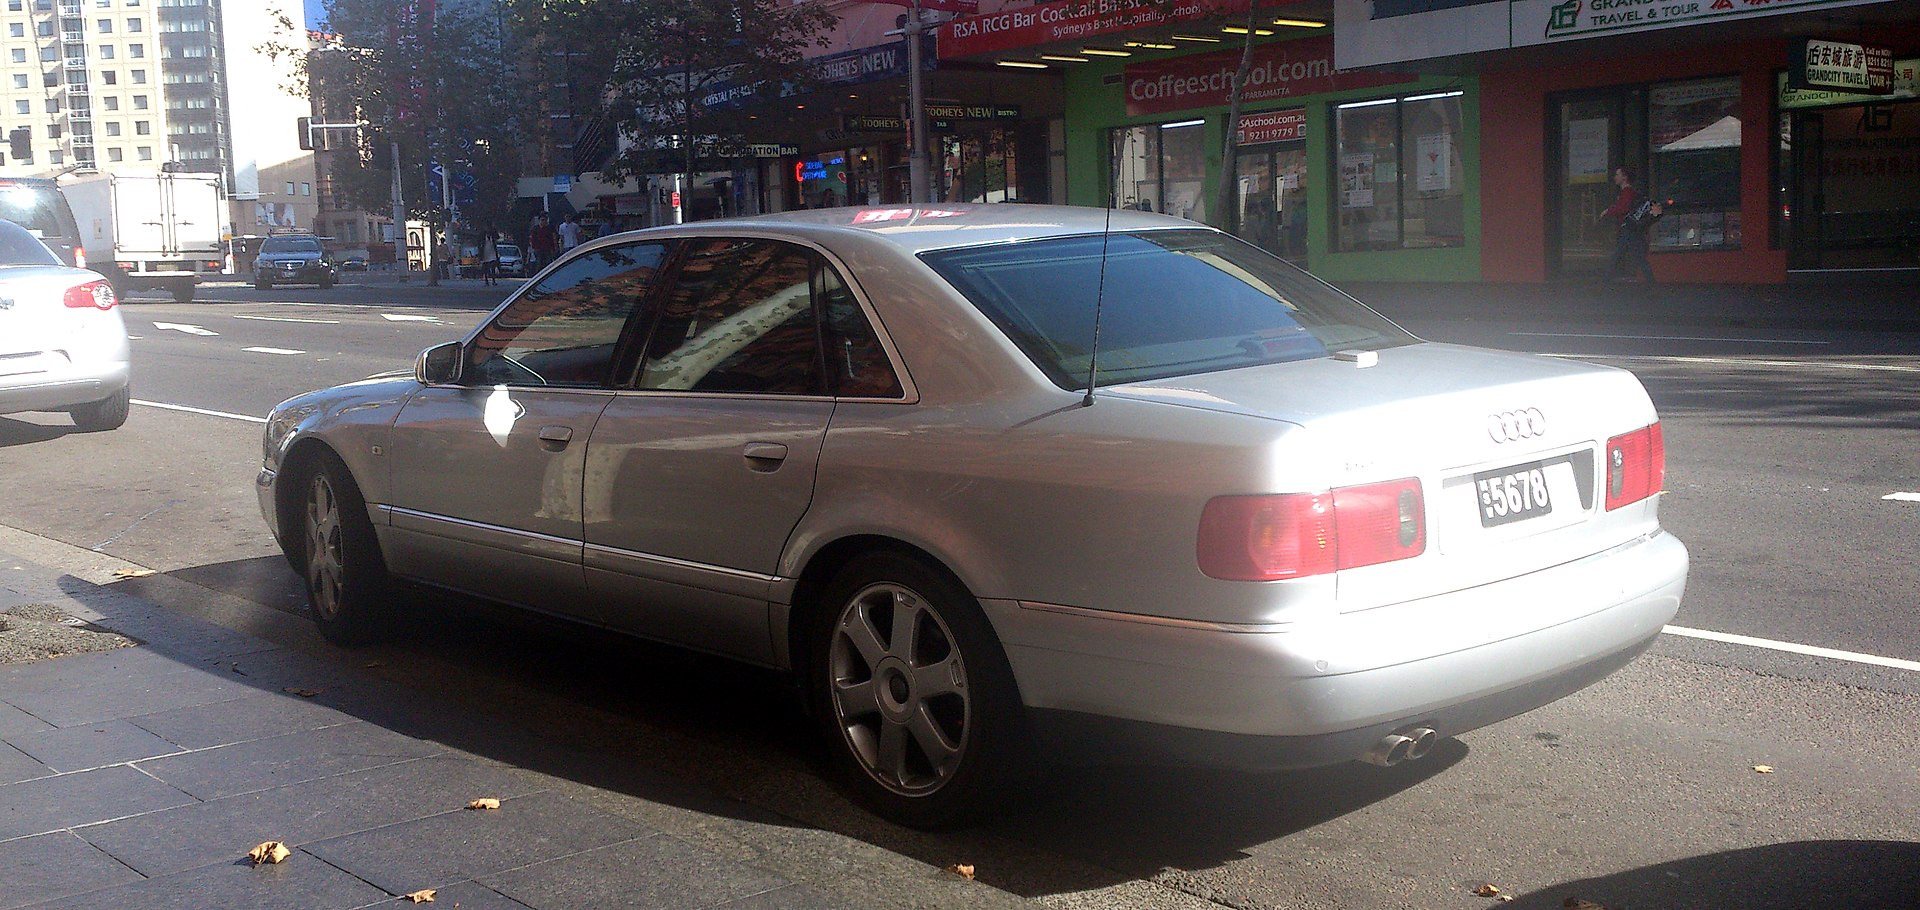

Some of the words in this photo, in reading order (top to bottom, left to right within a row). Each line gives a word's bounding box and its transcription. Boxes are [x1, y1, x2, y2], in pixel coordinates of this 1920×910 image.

[1053, 20, 1092, 38] Sydney's
[1168, 4, 1202, 18] chool
[1591, 11, 1643, 25] TRAVEL
[1647, 8, 1657, 19] &
[1662, 3, 1700, 17] TOUR
[953, 18, 978, 38] RSA
[982, 14, 1011, 33] RCG
[1014, 13, 1036, 28] Bar
[862, 50, 896, 74] NEW
[1131, 57, 1360, 101] Coffeeschol.com.
[1807, 68, 1841, 83] GRANDCITY
[1842, 71, 1863, 85] TRAVEL
[1869, 74, 1885, 87] TOUR
[704, 91, 728, 106] CRYSTAL
[1246, 87, 1290, 101] PARRAMATTA
[926, 106, 964, 118] TOOHEYS
[967, 107, 992, 119] NEW
[861, 118, 899, 129] TOOHEYS
[1238, 115, 1306, 129] SAschool.com.au
[1250, 130, 1270, 140] 9211
[1272, 127, 1293, 138] 9779
[781, 146, 798, 156] BAR
[1489, 467, 1549, 518] 5678
